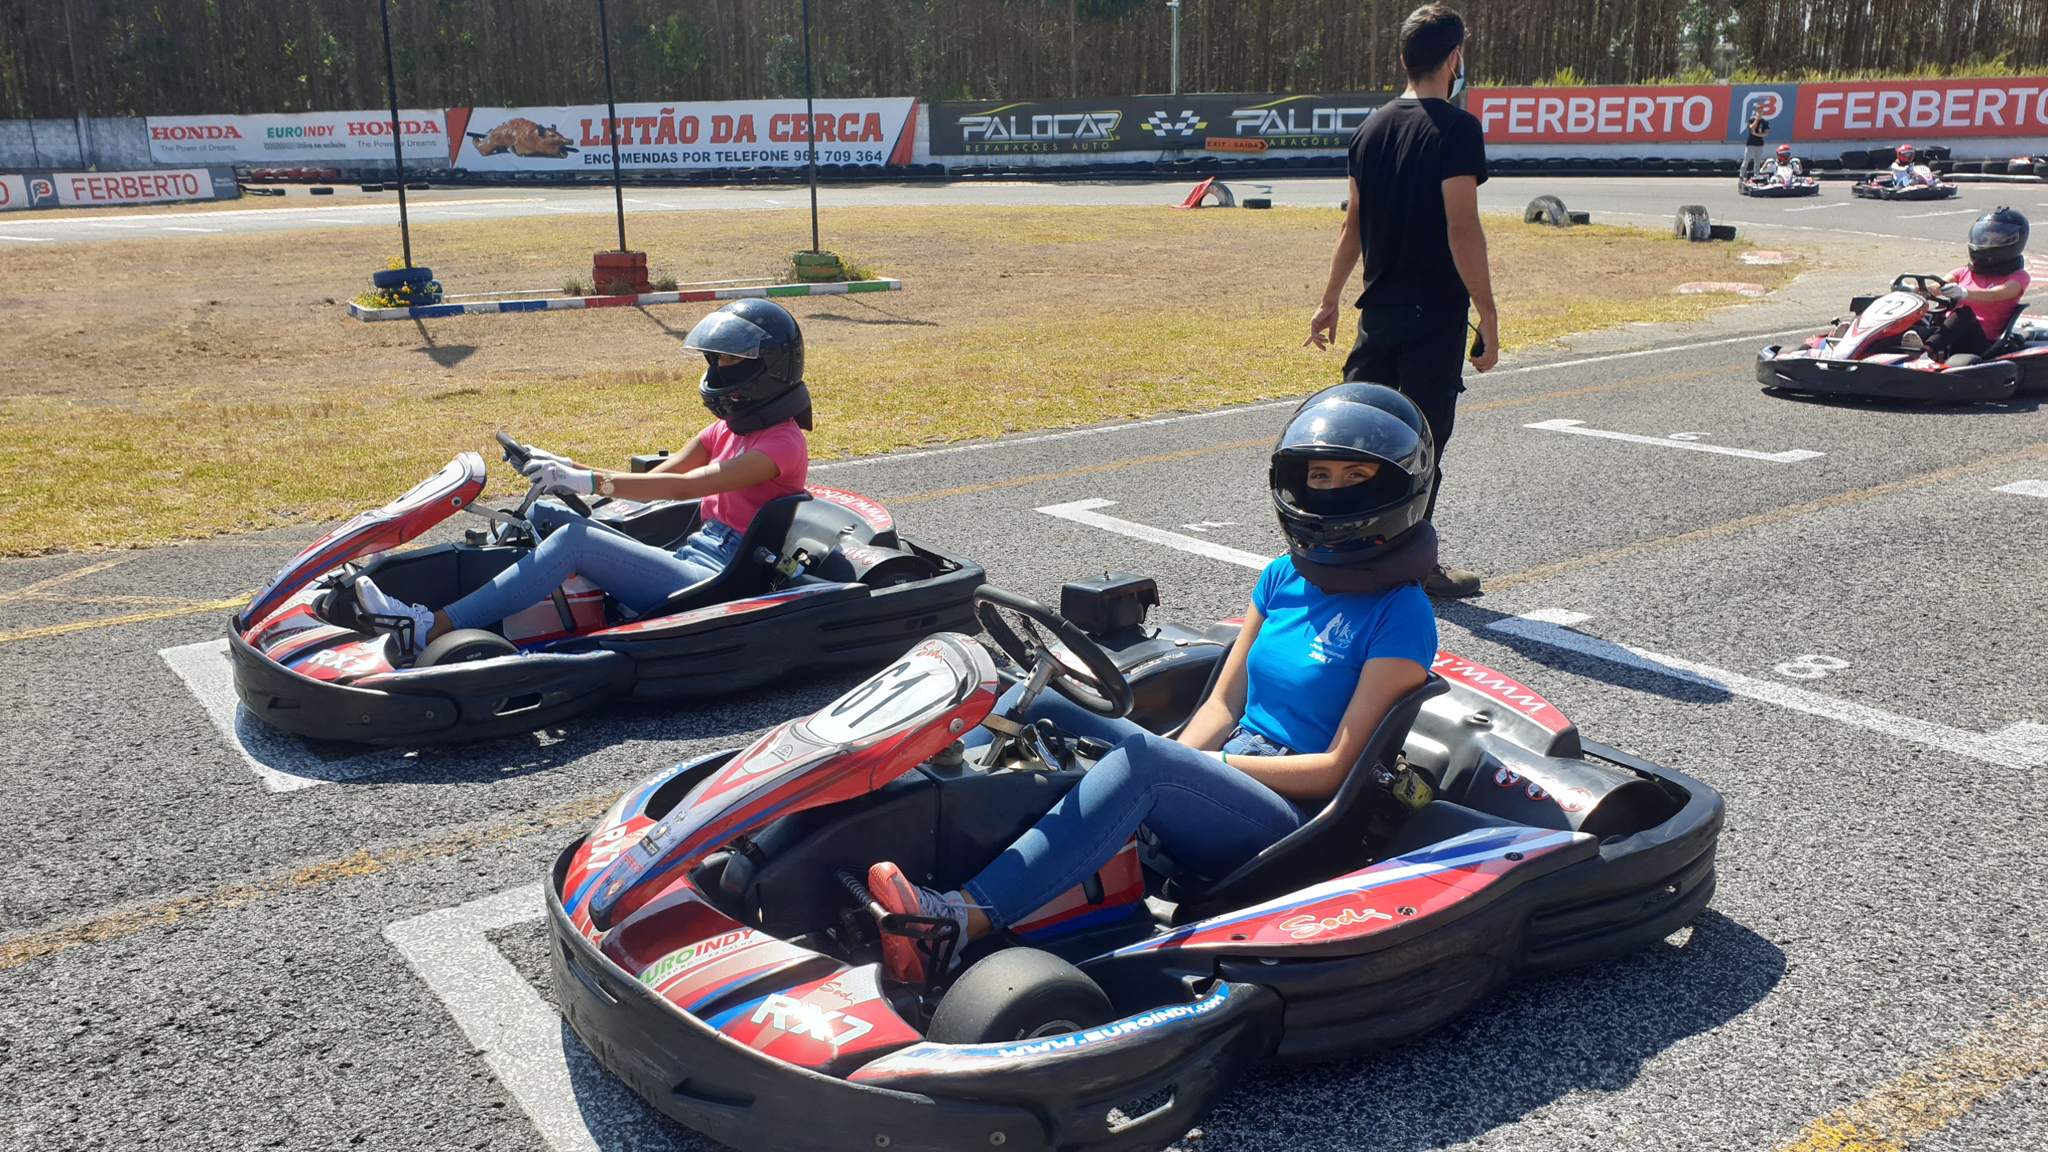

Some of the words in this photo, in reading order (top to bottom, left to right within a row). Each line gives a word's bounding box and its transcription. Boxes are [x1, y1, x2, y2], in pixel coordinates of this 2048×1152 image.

[580, 107, 700, 147] LEITÃO
[710, 114, 757, 144] DA
[769, 113, 884, 142] CERCA
[959, 112, 1120, 141] PALOCAR
[1232, 107, 1381, 136] PALOC
[1482, 95, 1713, 133] FERBERTO
[151, 125, 243, 140] HONDA
[267, 125, 335, 138] EUROINDY
[347, 120, 441, 136] HONDA
[374, 140, 395, 148] Powe
[966, 142, 1058, 152] REPARAÇÕES
[1072, 142, 1109, 151] AUTO
[1269, 137, 1340, 146] ARAÇÕES
[683, 152, 711, 163] POR
[716, 150, 789, 162] TELEFONE
[825, 151, 851, 162] 709
[856, 151, 882, 162] 364
[71, 173, 199, 201] FERBERTO
[1774, 655, 1850, 679] 8
[831, 662, 931, 728] 61
[1280, 909, 1392, 938] Sodi
[751, 993, 874, 1047] RX7
